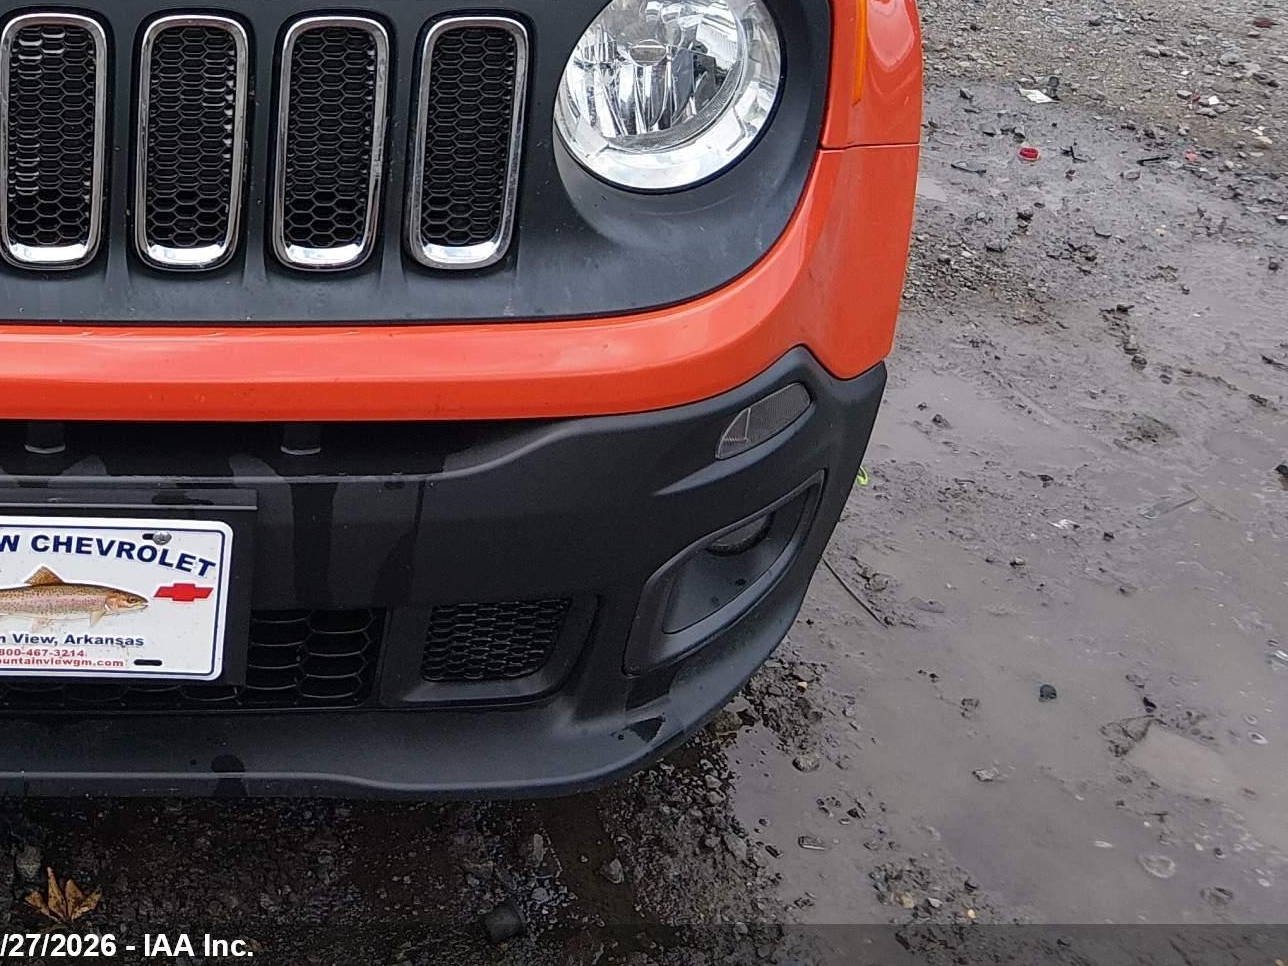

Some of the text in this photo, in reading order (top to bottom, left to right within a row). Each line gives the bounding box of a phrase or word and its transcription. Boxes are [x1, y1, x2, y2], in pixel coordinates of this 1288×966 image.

[30, 534, 216, 578] CHEVROLET
[12, 633, 59, 647] View,
[63, 633, 144, 647] Arkansas
